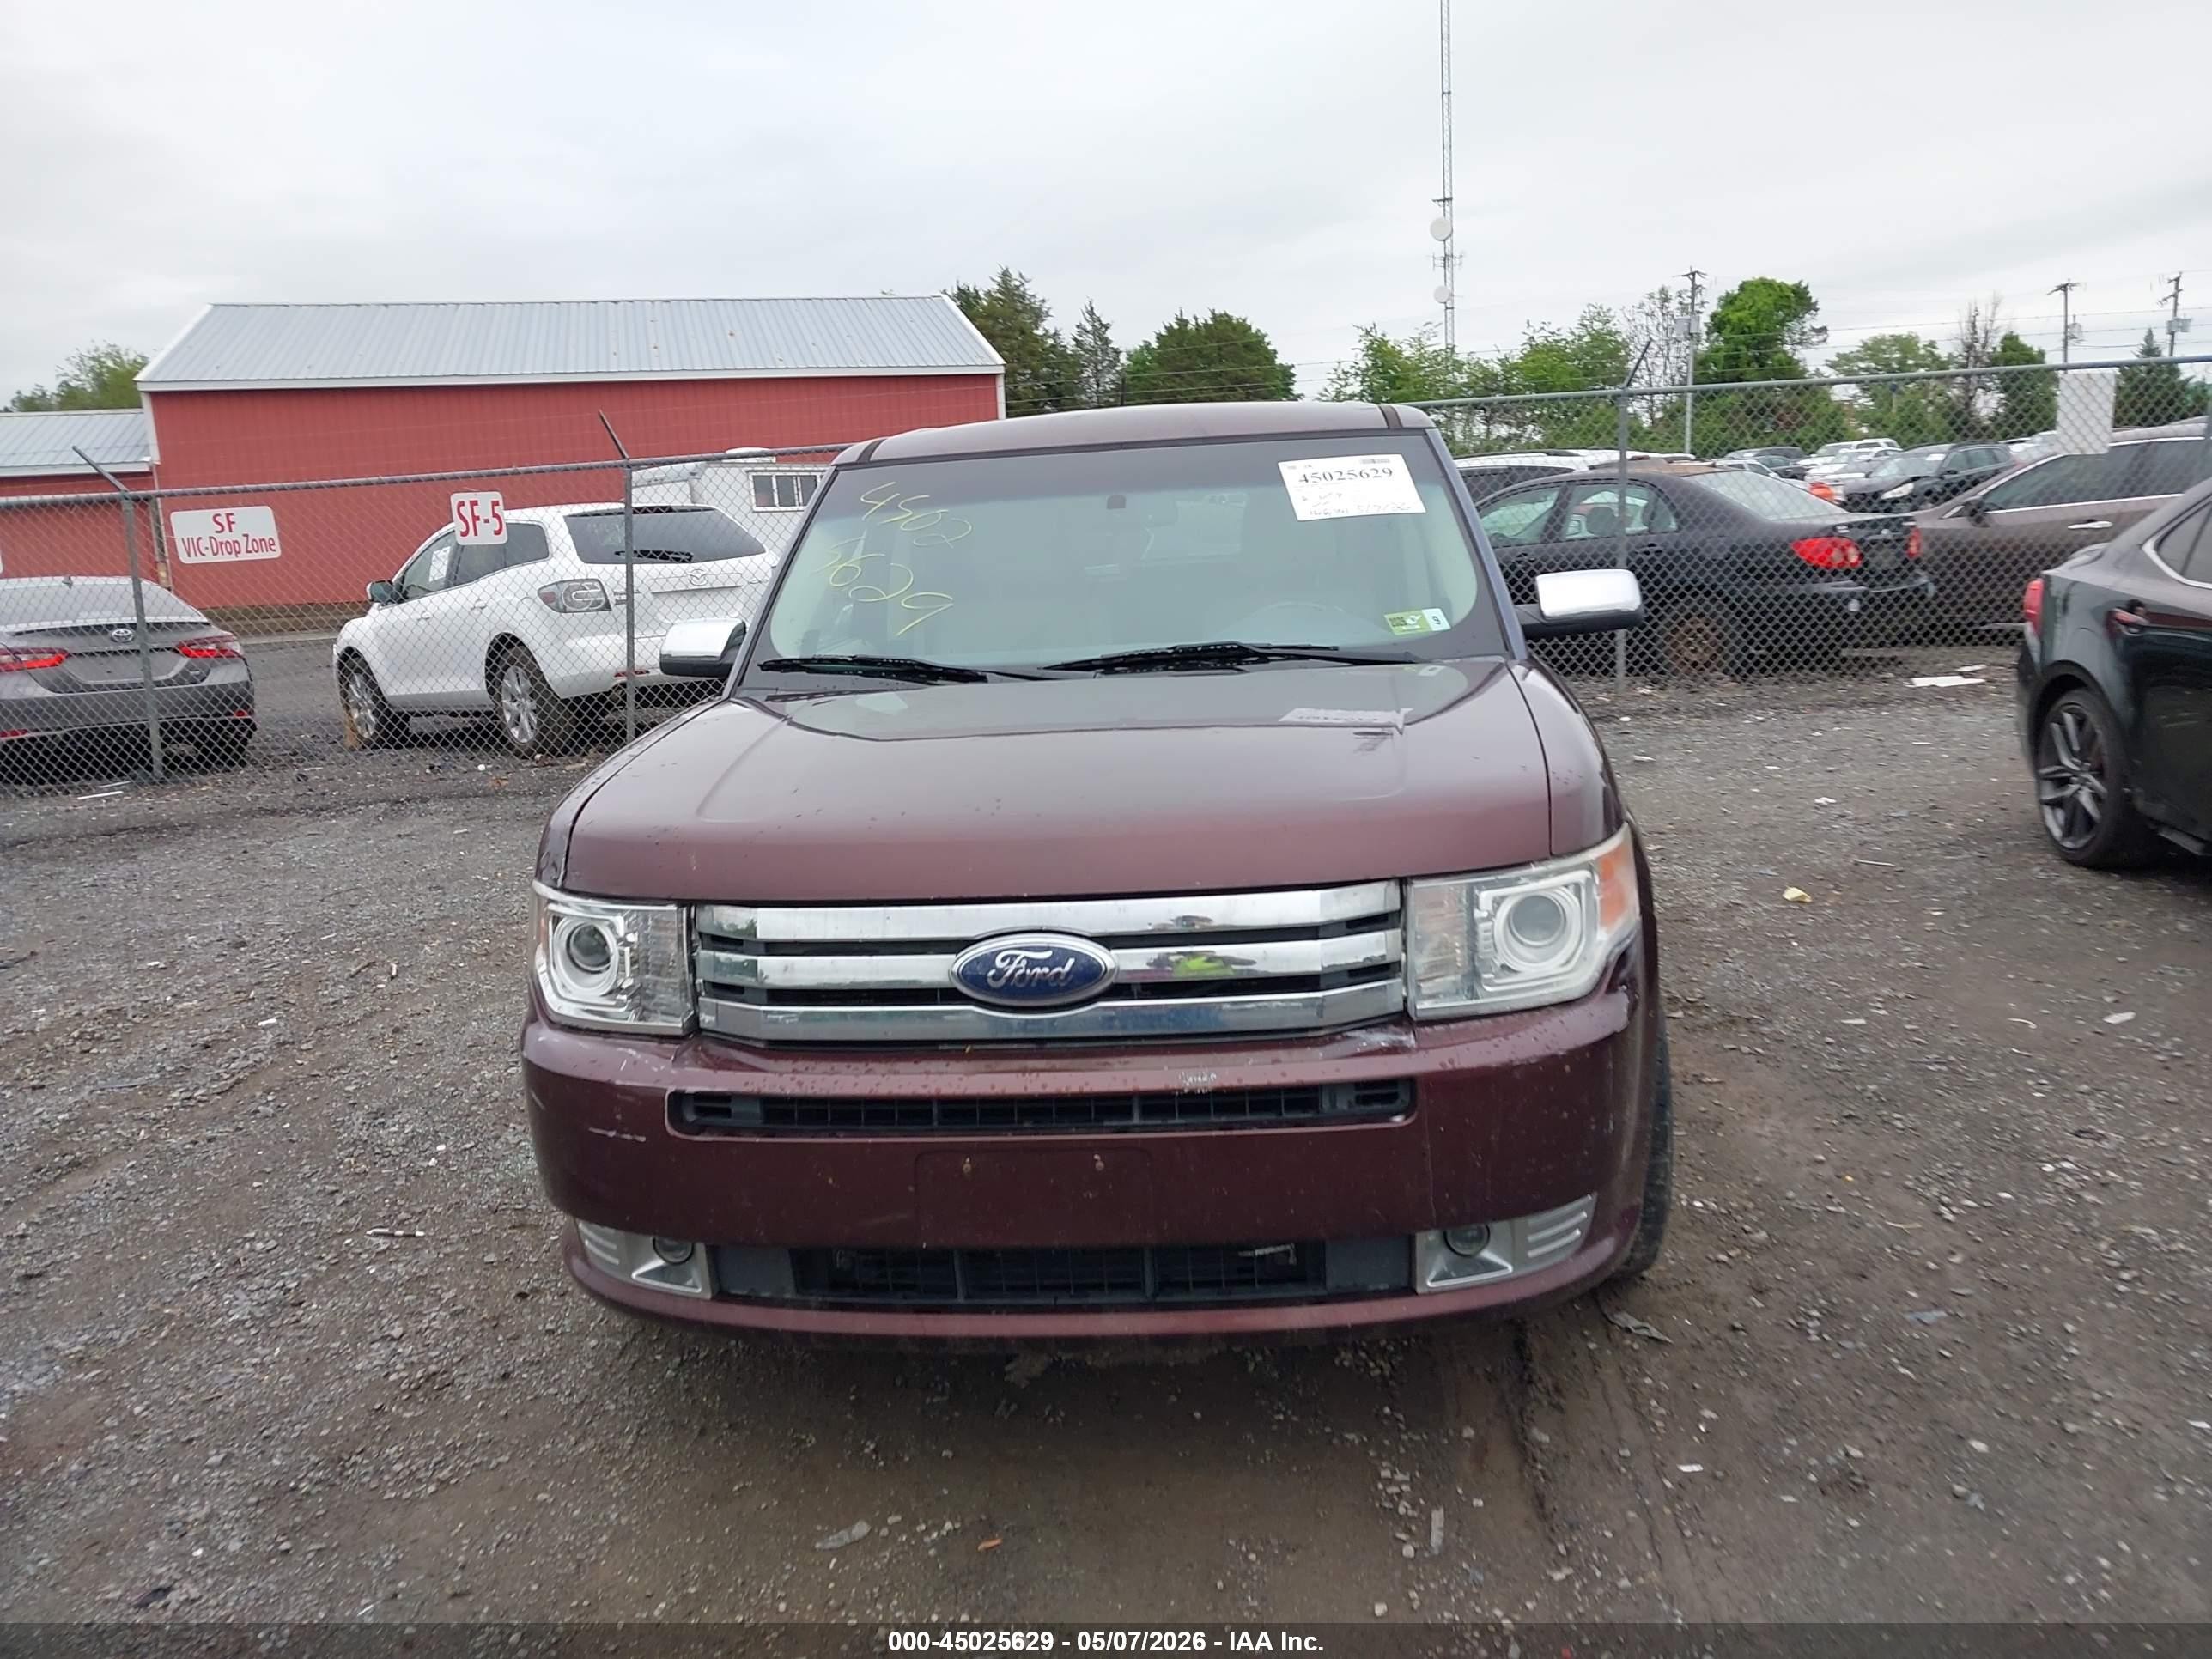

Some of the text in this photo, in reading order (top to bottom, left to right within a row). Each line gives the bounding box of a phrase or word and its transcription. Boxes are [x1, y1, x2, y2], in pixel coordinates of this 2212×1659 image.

[1298, 467, 1393, 483] 45025629
[211, 513, 236, 534] SF
[456, 500, 503, 538] SF-5
[860, 481, 973, 549] 4502
[181, 533, 276, 558] VIC-Drop Zone
[988, 950, 1075, 988] Ford
